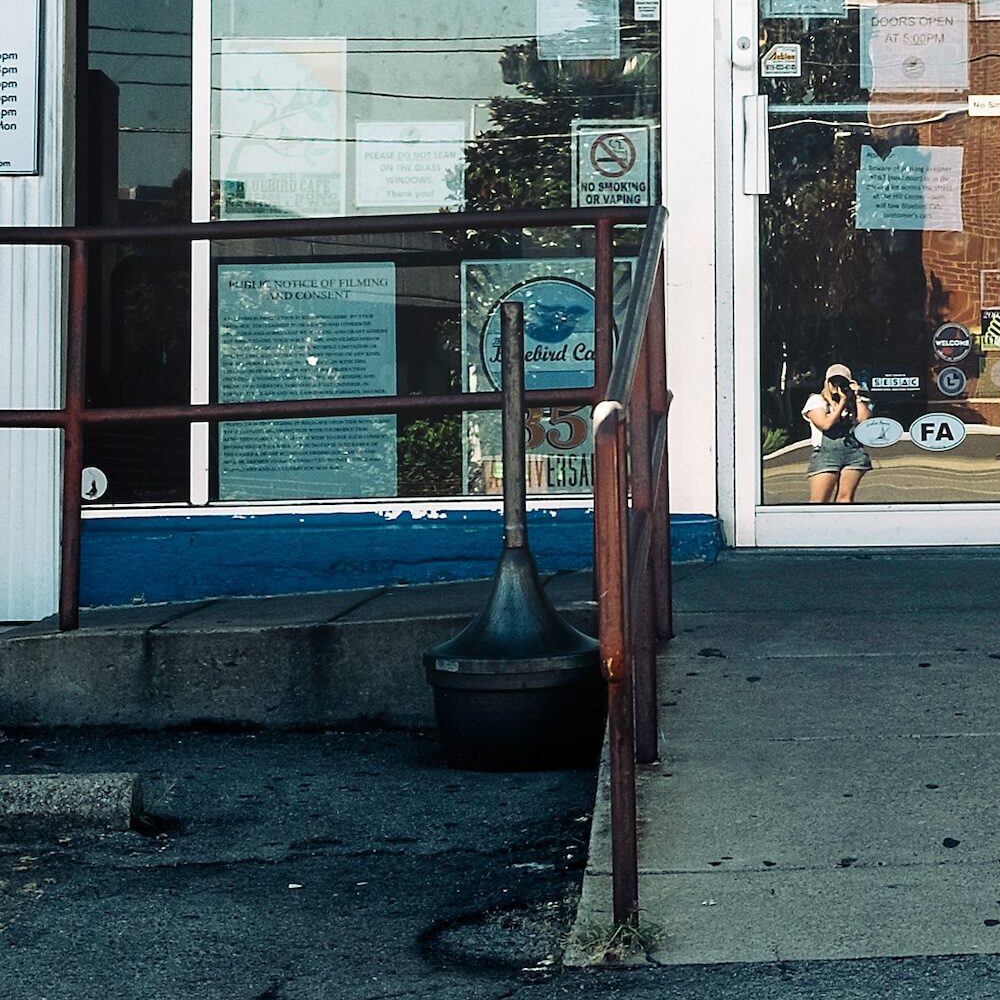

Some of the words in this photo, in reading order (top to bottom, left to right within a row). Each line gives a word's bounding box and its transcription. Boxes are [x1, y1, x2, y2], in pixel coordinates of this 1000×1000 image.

[871, 16, 916, 27] DOORS
[919, 16, 954, 27] OPEN
[884, 33, 900, 43] AT
[0, 53, 18, 62] pm
[0, 67, 18, 76] pm
[0, 81, 18, 90] pm
[0, 95, 17, 104] pm
[365, 151, 394, 159] PLEASE
[398, 151, 411, 159] DO
[413, 151, 431, 159] NOT
[380, 164, 394, 172] ON
[580, 182, 596, 192] NO
[598, 182, 646, 192] SMOKING
[585, 194, 600, 205] OR
[602, 194, 641, 205] VAPING
[228, 279, 272, 290] PUBLIC
[274, 279, 318, 289] NOTICE
[320, 278, 336, 288] OF
[338, 277, 389, 288] FILMING
[267, 291, 293, 301] AND
[294, 290, 352, 301] CONSENT
[873, 378, 918, 387] SESAC
[920, 422, 955, 441] FA
